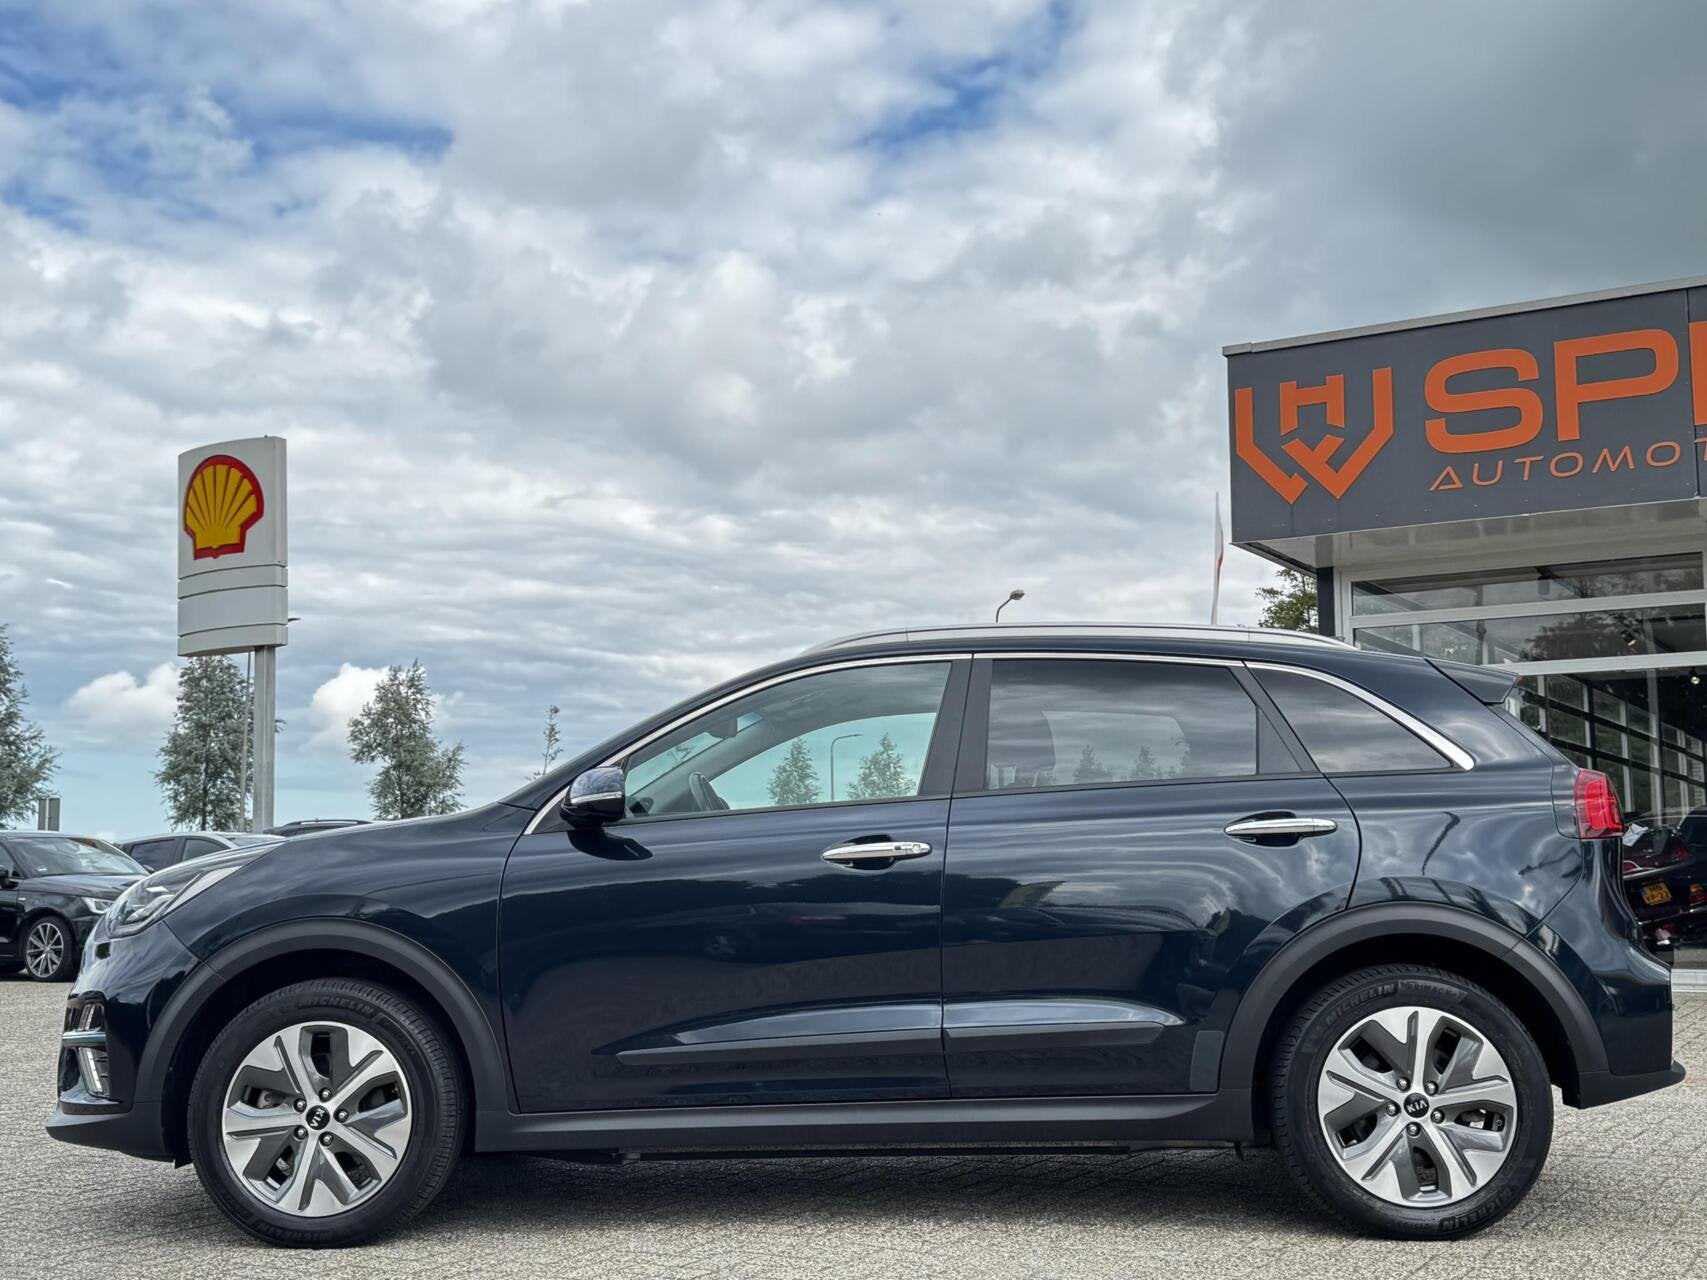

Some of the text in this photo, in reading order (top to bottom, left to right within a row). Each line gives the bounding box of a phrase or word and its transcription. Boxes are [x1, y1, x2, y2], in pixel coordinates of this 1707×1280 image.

[298, 996, 375, 1018] MICHELIN
[1326, 983, 1396, 1025] MICHELIN
[1407, 1100, 1428, 1113] KIA
[310, 1108, 325, 1127] KIA
